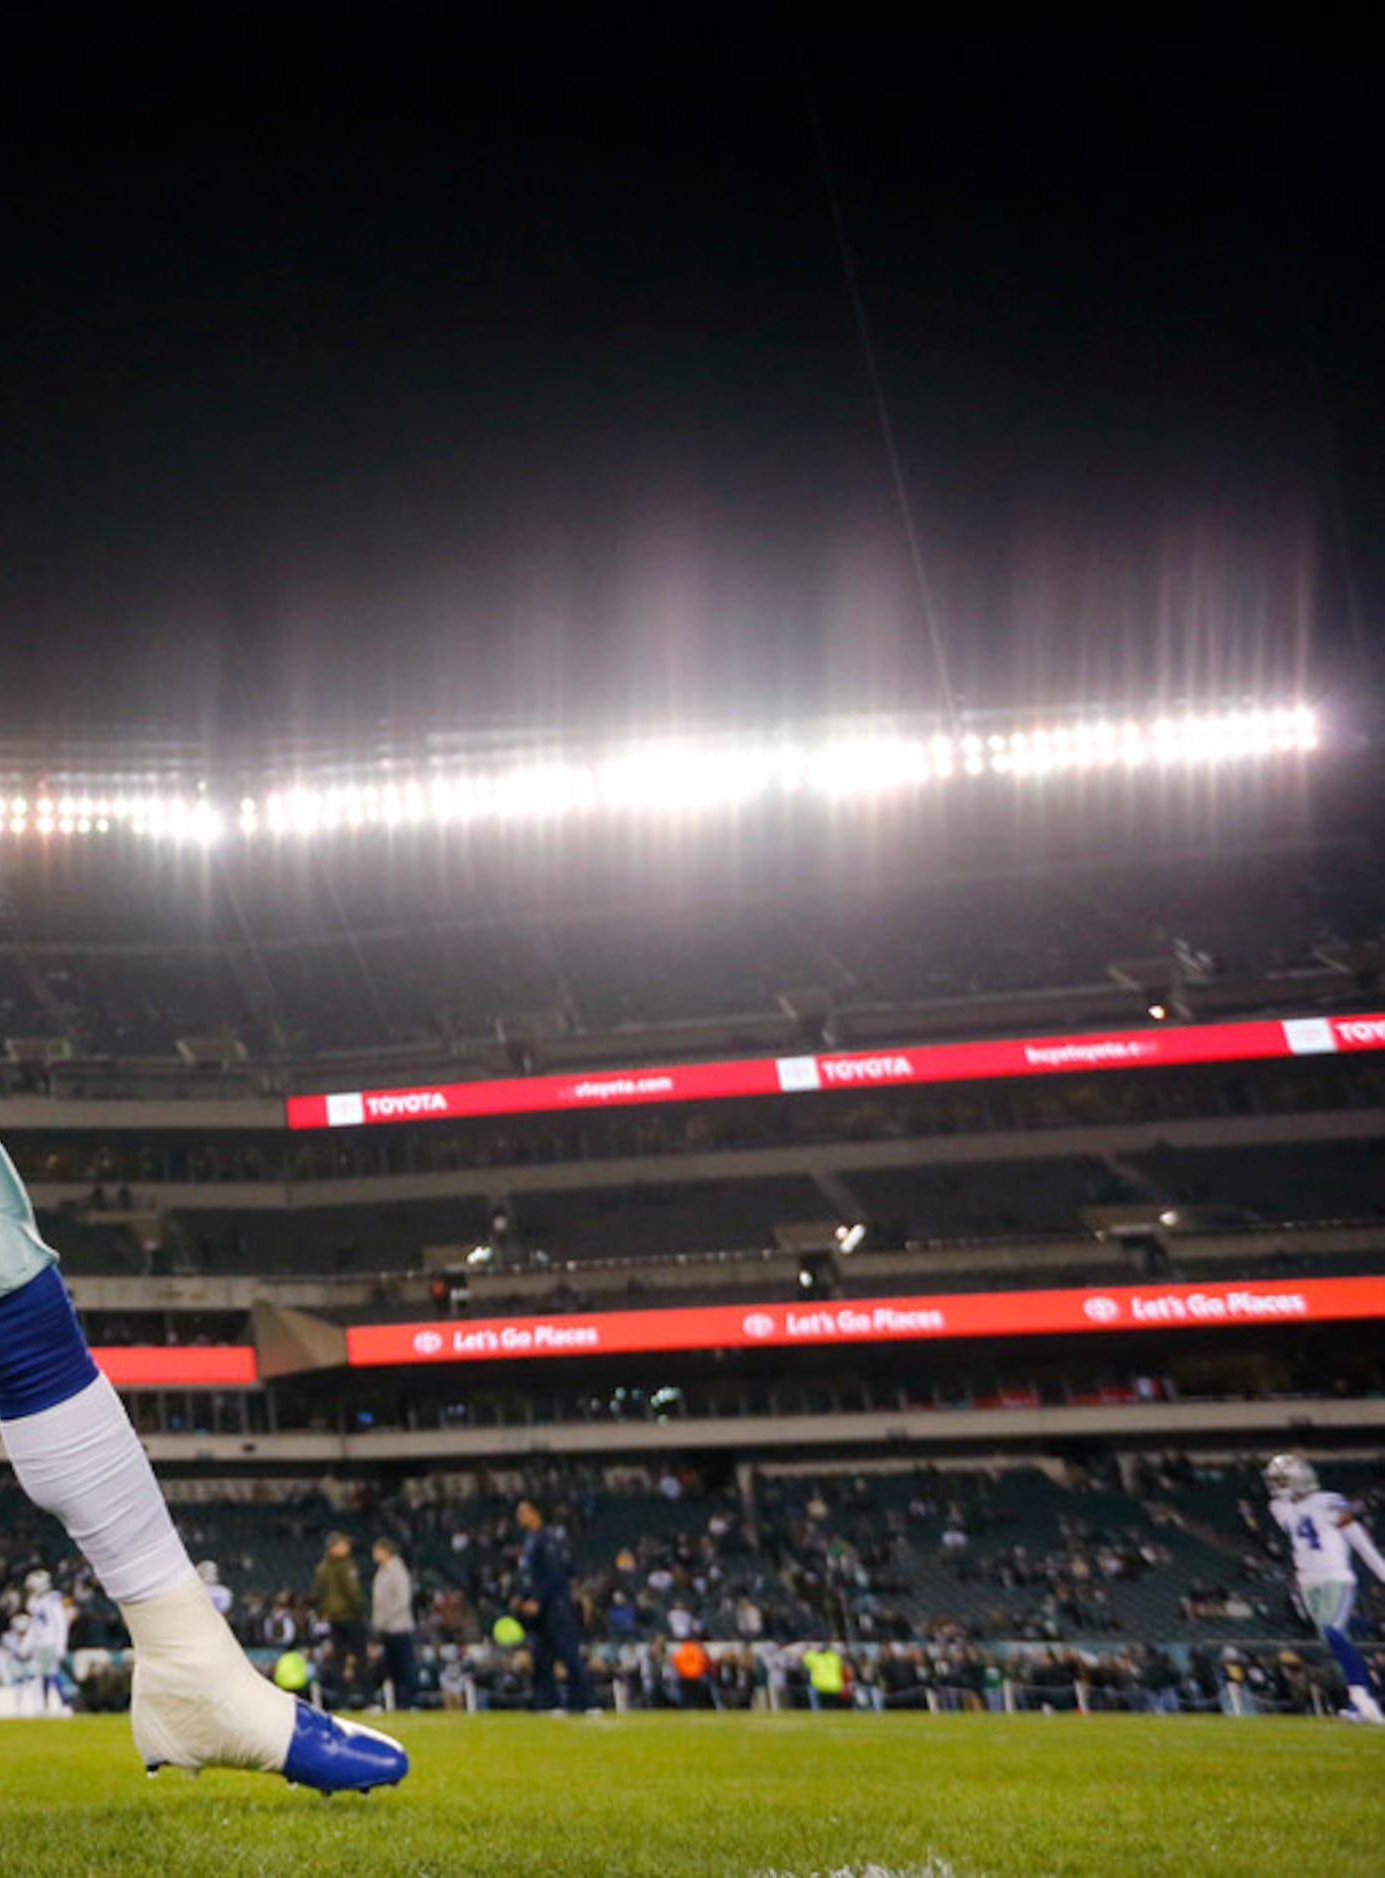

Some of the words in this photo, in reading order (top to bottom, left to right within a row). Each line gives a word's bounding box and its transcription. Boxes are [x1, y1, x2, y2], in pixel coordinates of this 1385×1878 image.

[821, 1056, 914, 1082] TOYOTA
[366, 1092, 447, 1116] TOYOTA
[1131, 1296, 1187, 1321] Let's
[1187, 1293, 1226, 1318] Go
[1227, 1292, 1307, 1316] Places
[786, 1311, 835, 1335] Let's
[837, 1309, 871, 1333] Go
[873, 1308, 944, 1331] Places
[453, 1330, 499, 1351] Let's
[500, 1327, 532, 1349] Go
[534, 1325, 598, 1347] Places
